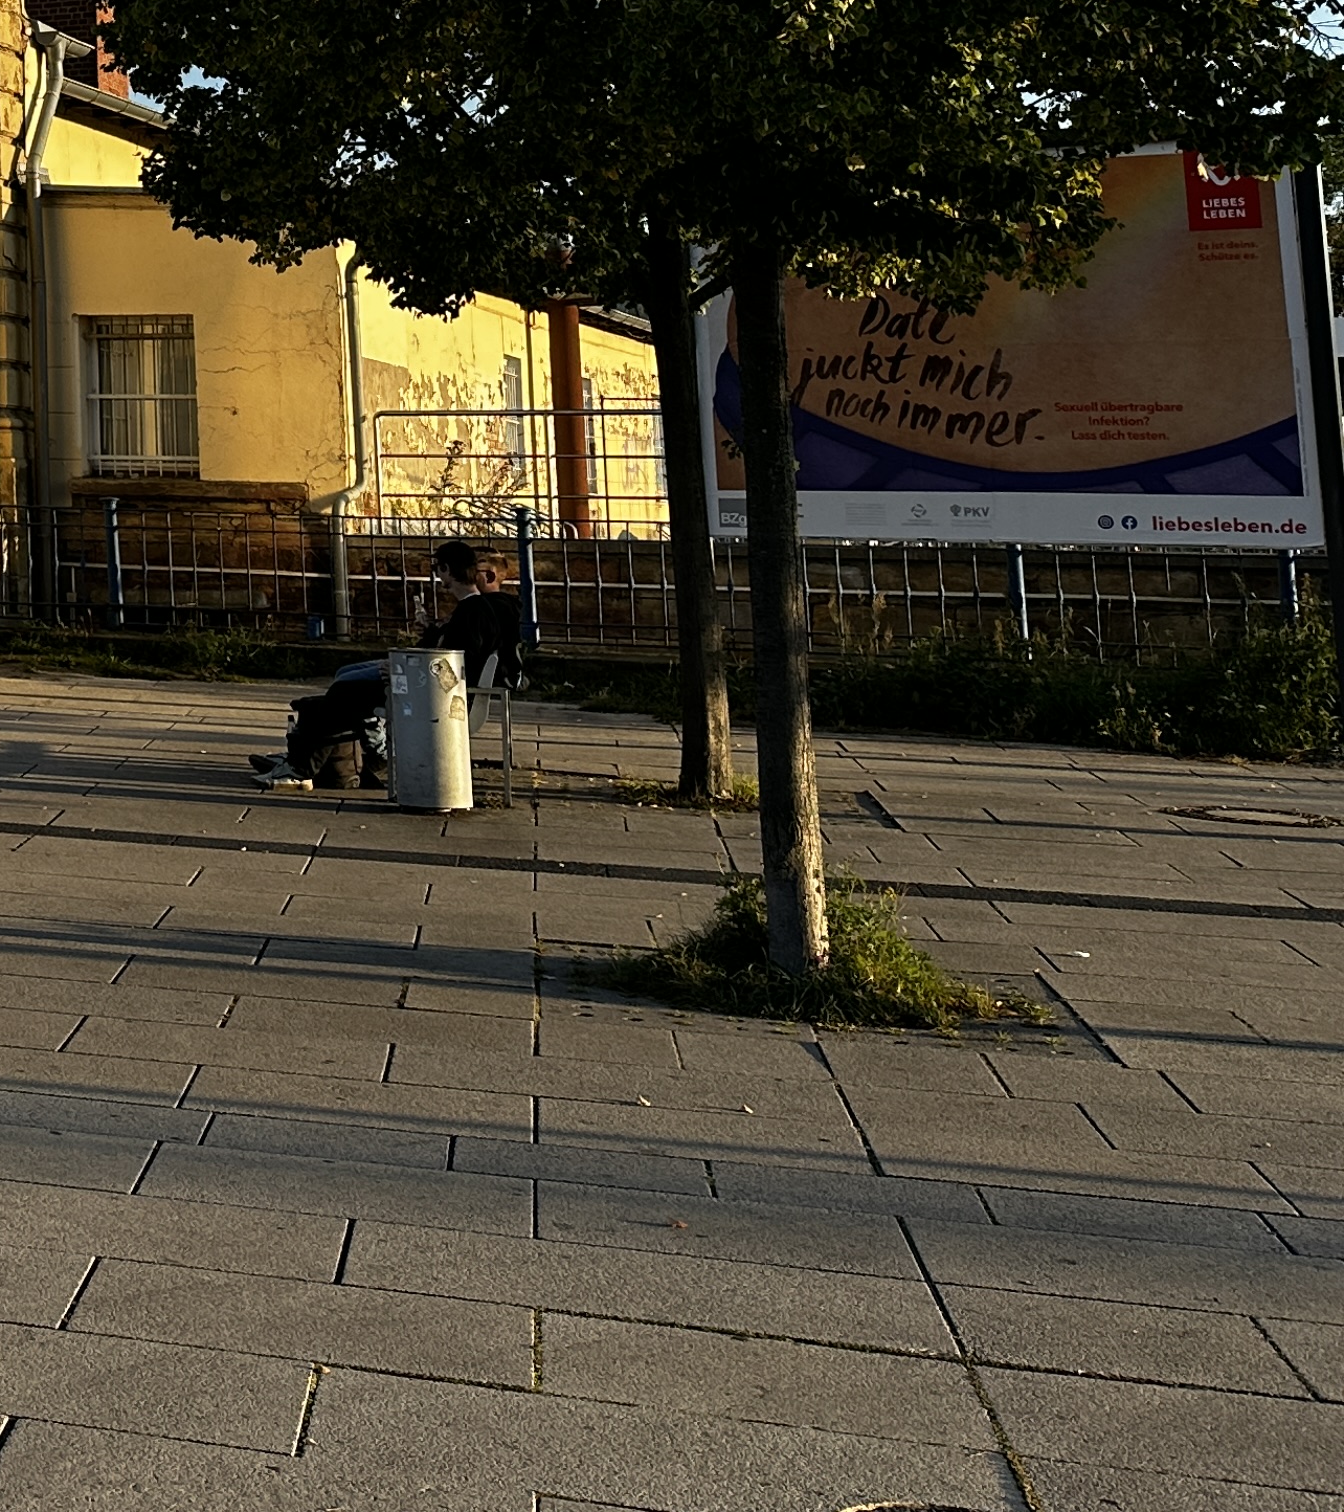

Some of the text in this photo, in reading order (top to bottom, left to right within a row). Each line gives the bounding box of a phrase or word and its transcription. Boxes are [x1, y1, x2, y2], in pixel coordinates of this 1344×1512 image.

[1201, 197, 1246, 208] LIEBES
[1203, 208, 1247, 220] LEBEN
[1197, 241, 1258, 250] Es ist deins.
[1198, 253, 1241, 262] Schütze
[791, 341, 1013, 407] juckt mich
[1054, 401, 1184, 414] Sexuell übertragbare
[825, 388, 1045, 448] noch immer.
[1088, 416, 1150, 426] Infektion?
[1071, 430, 1170, 441] Lass dich testen.
[963, 506, 990, 517] PKV
[720, 512, 748, 527] BZg
[1152, 515, 1307, 534] liebesleben.de
